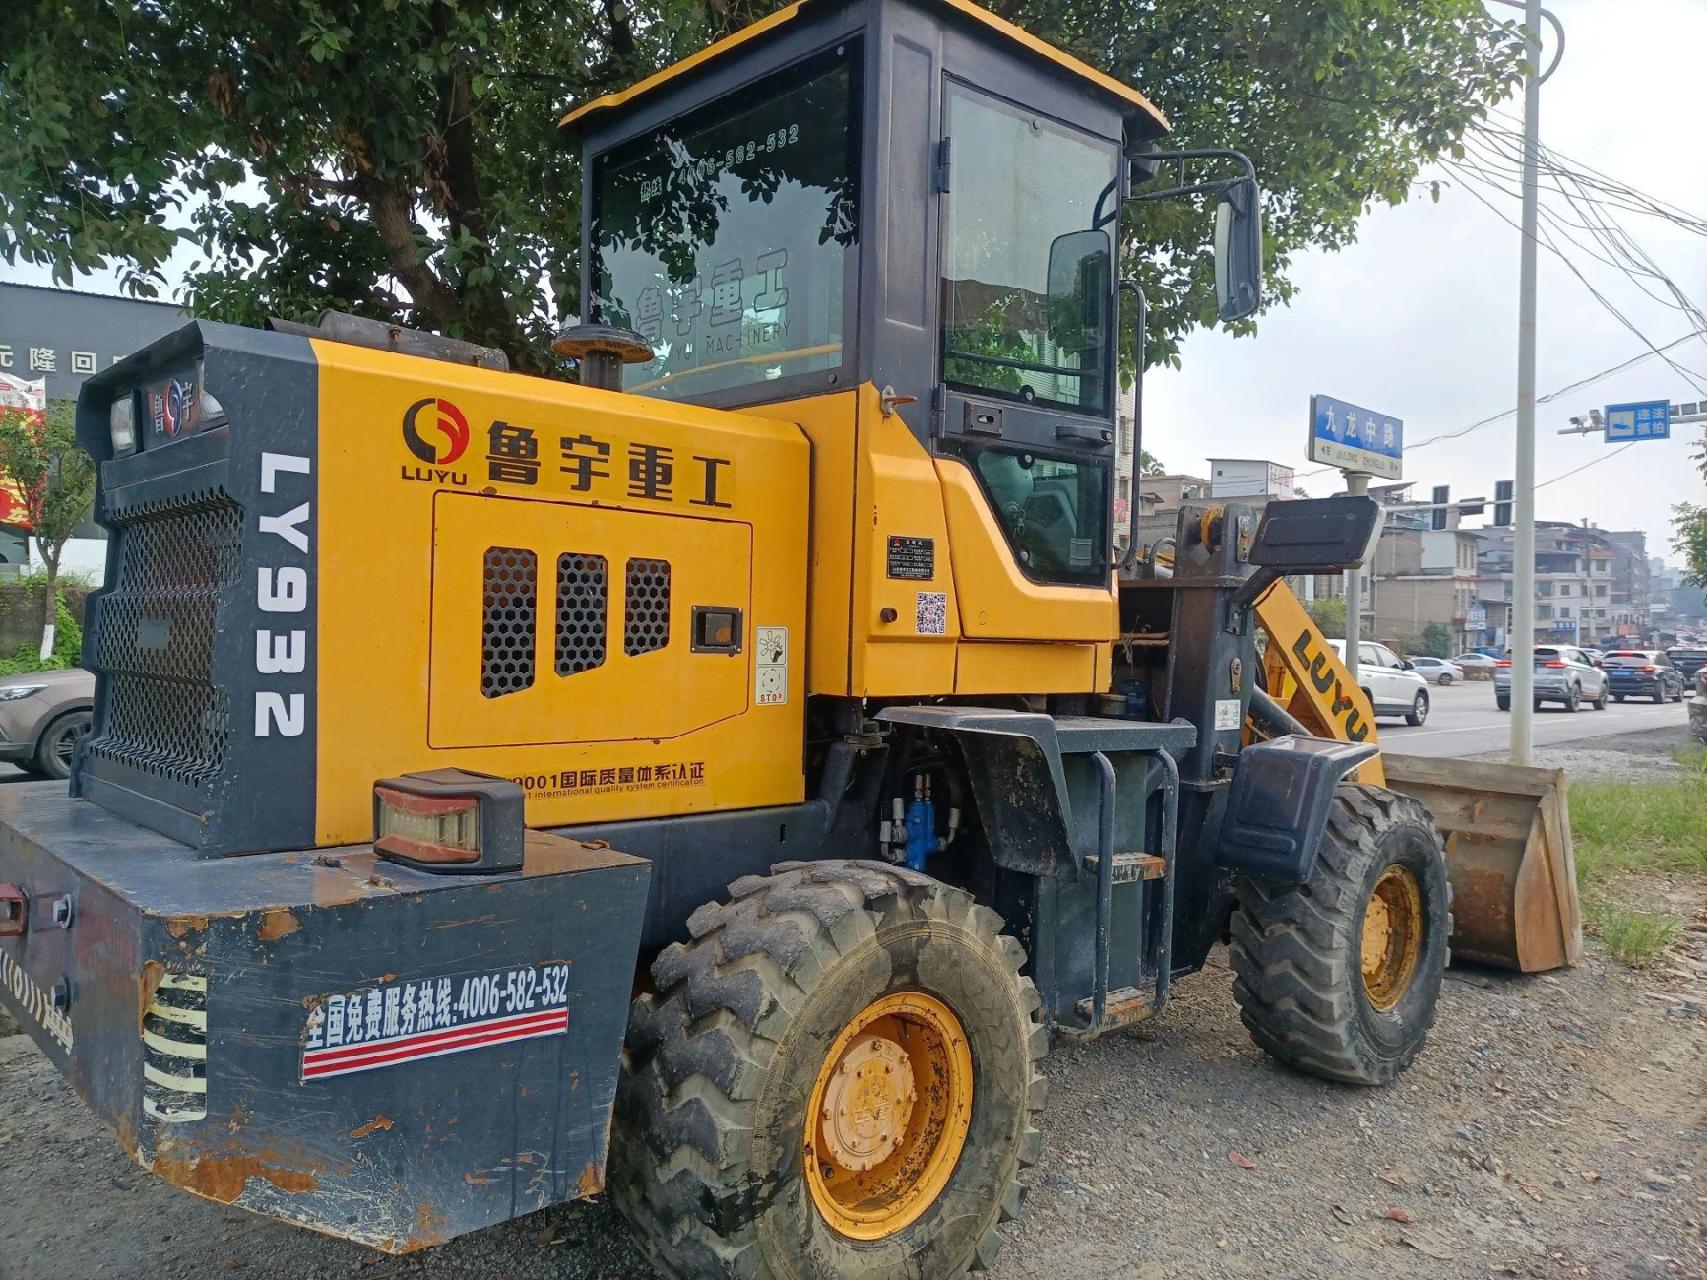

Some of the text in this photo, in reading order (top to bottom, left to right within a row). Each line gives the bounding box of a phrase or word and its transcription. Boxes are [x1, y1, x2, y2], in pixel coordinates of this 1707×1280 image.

[401, 465, 468, 486] LUYU
[485, 420, 733, 508] 鲁宇重工
[254, 452, 310, 737] LY932
[760, 693, 784, 703] STOP
[1292, 628, 1369, 742] LUYU
